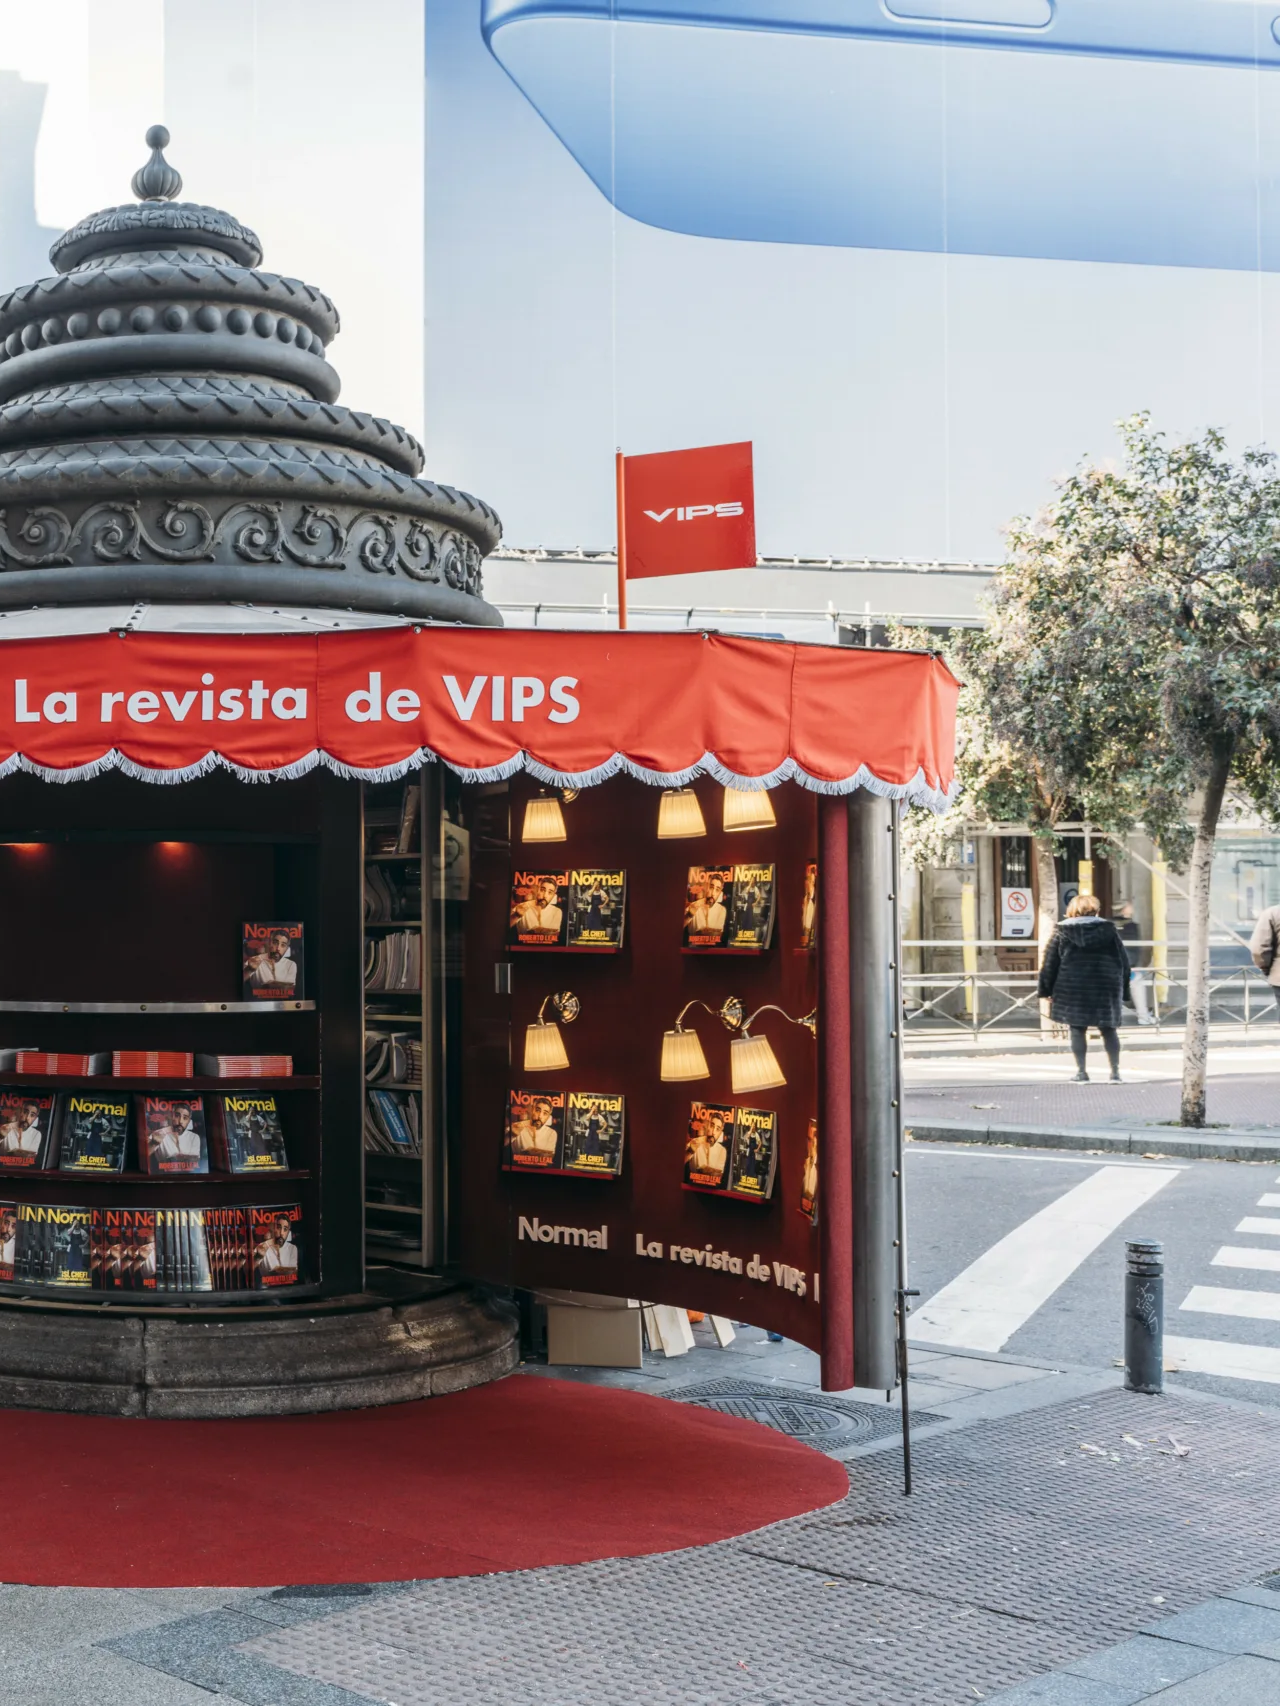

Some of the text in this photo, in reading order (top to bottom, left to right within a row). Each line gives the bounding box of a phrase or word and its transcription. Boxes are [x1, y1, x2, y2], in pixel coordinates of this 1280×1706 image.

[643, 501, 744, 523] VIPS
[15, 672, 580, 724] La revista de VIPS
[571, 870, 624, 886] Normal
[734, 866, 772, 882] Normal
[70, 1097, 127, 1117] Normal
[225, 1096, 276, 1112] Normal
[569, 1093, 622, 1112] Normal
[737, 1108, 773, 1130] Normal
[518, 1216, 608, 1250] Normal
[636, 1233, 663, 1258] La
[670, 1244, 743, 1275] revista
[746, 1254, 770, 1282] de
[772, 1261, 807, 1297] VIPS
